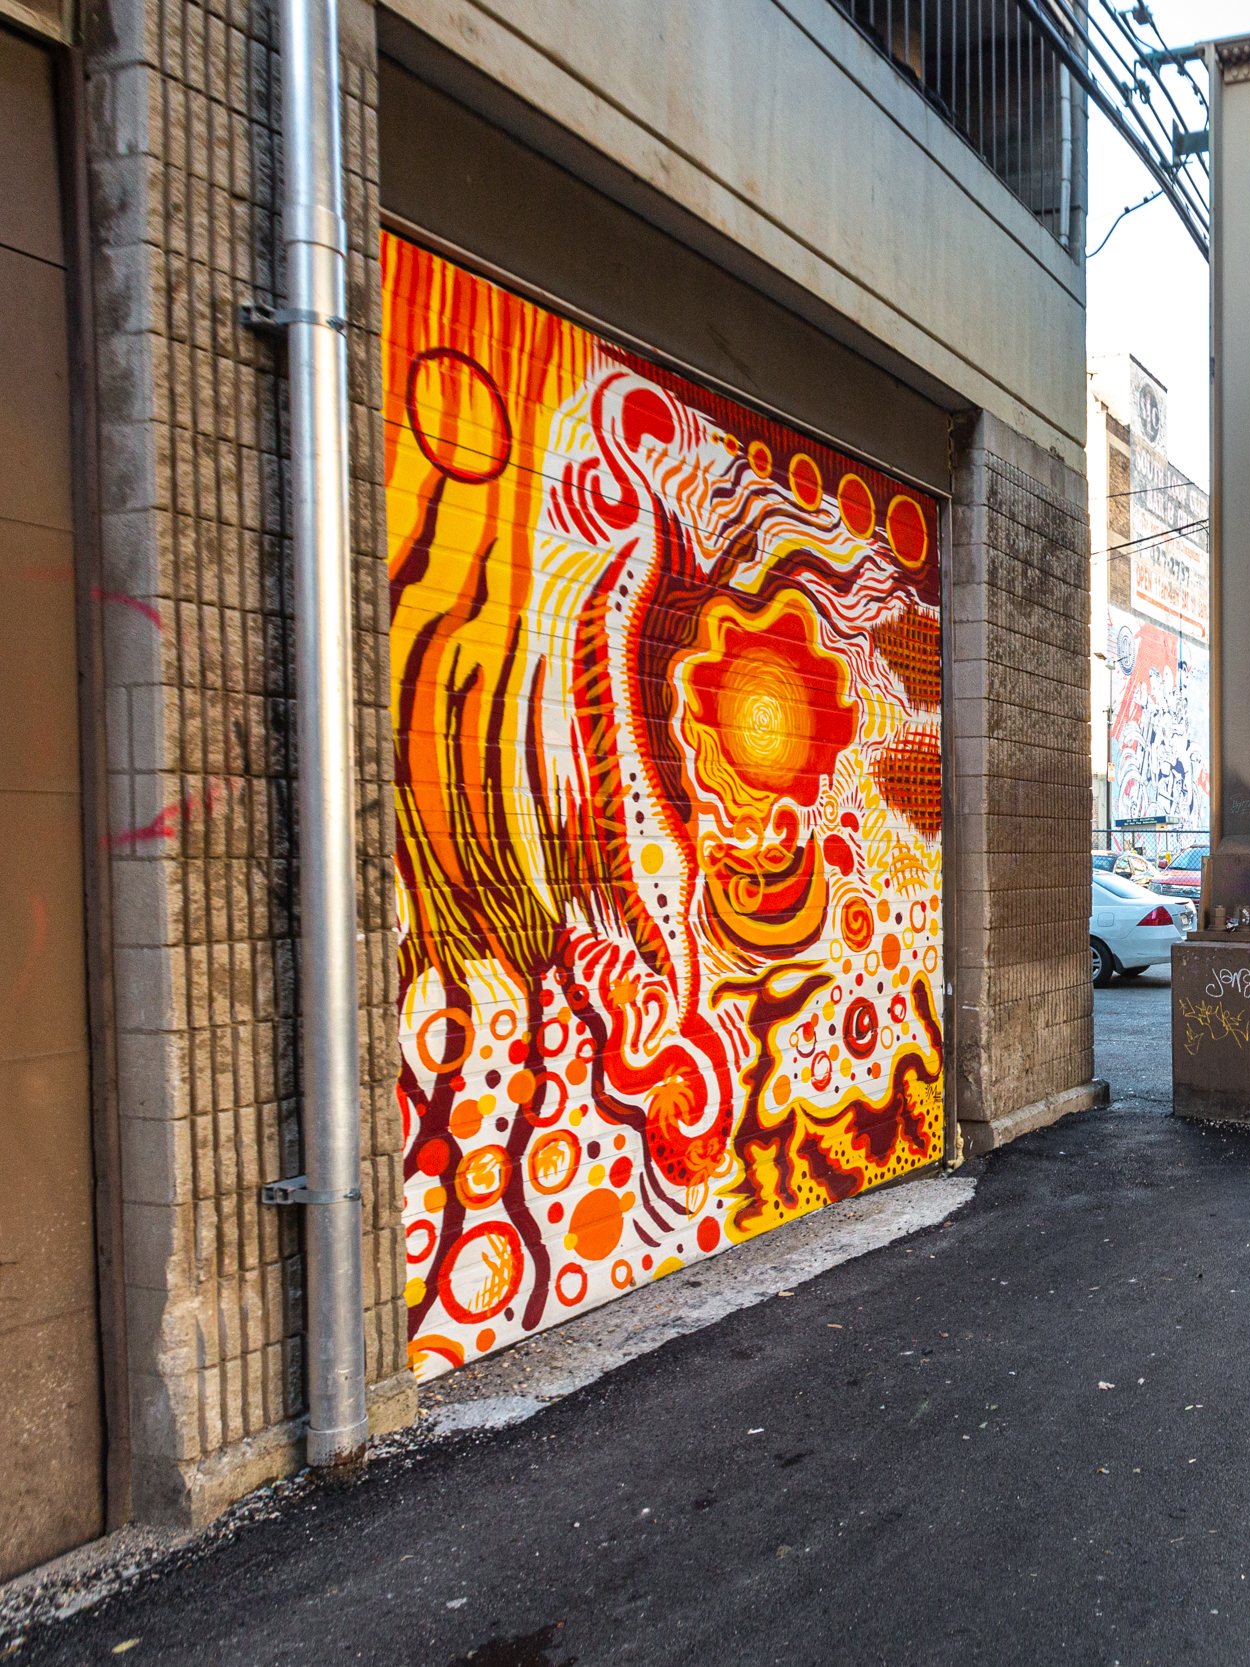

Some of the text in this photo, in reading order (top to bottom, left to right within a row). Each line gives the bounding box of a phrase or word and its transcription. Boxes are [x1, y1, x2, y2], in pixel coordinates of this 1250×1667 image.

[1134, 445, 1165, 488] SOUTH
[1167, 468, 1187, 506] LOOP
[1146, 483, 1165, 521] BAR
[1136, 562, 1152, 593] OPEN
